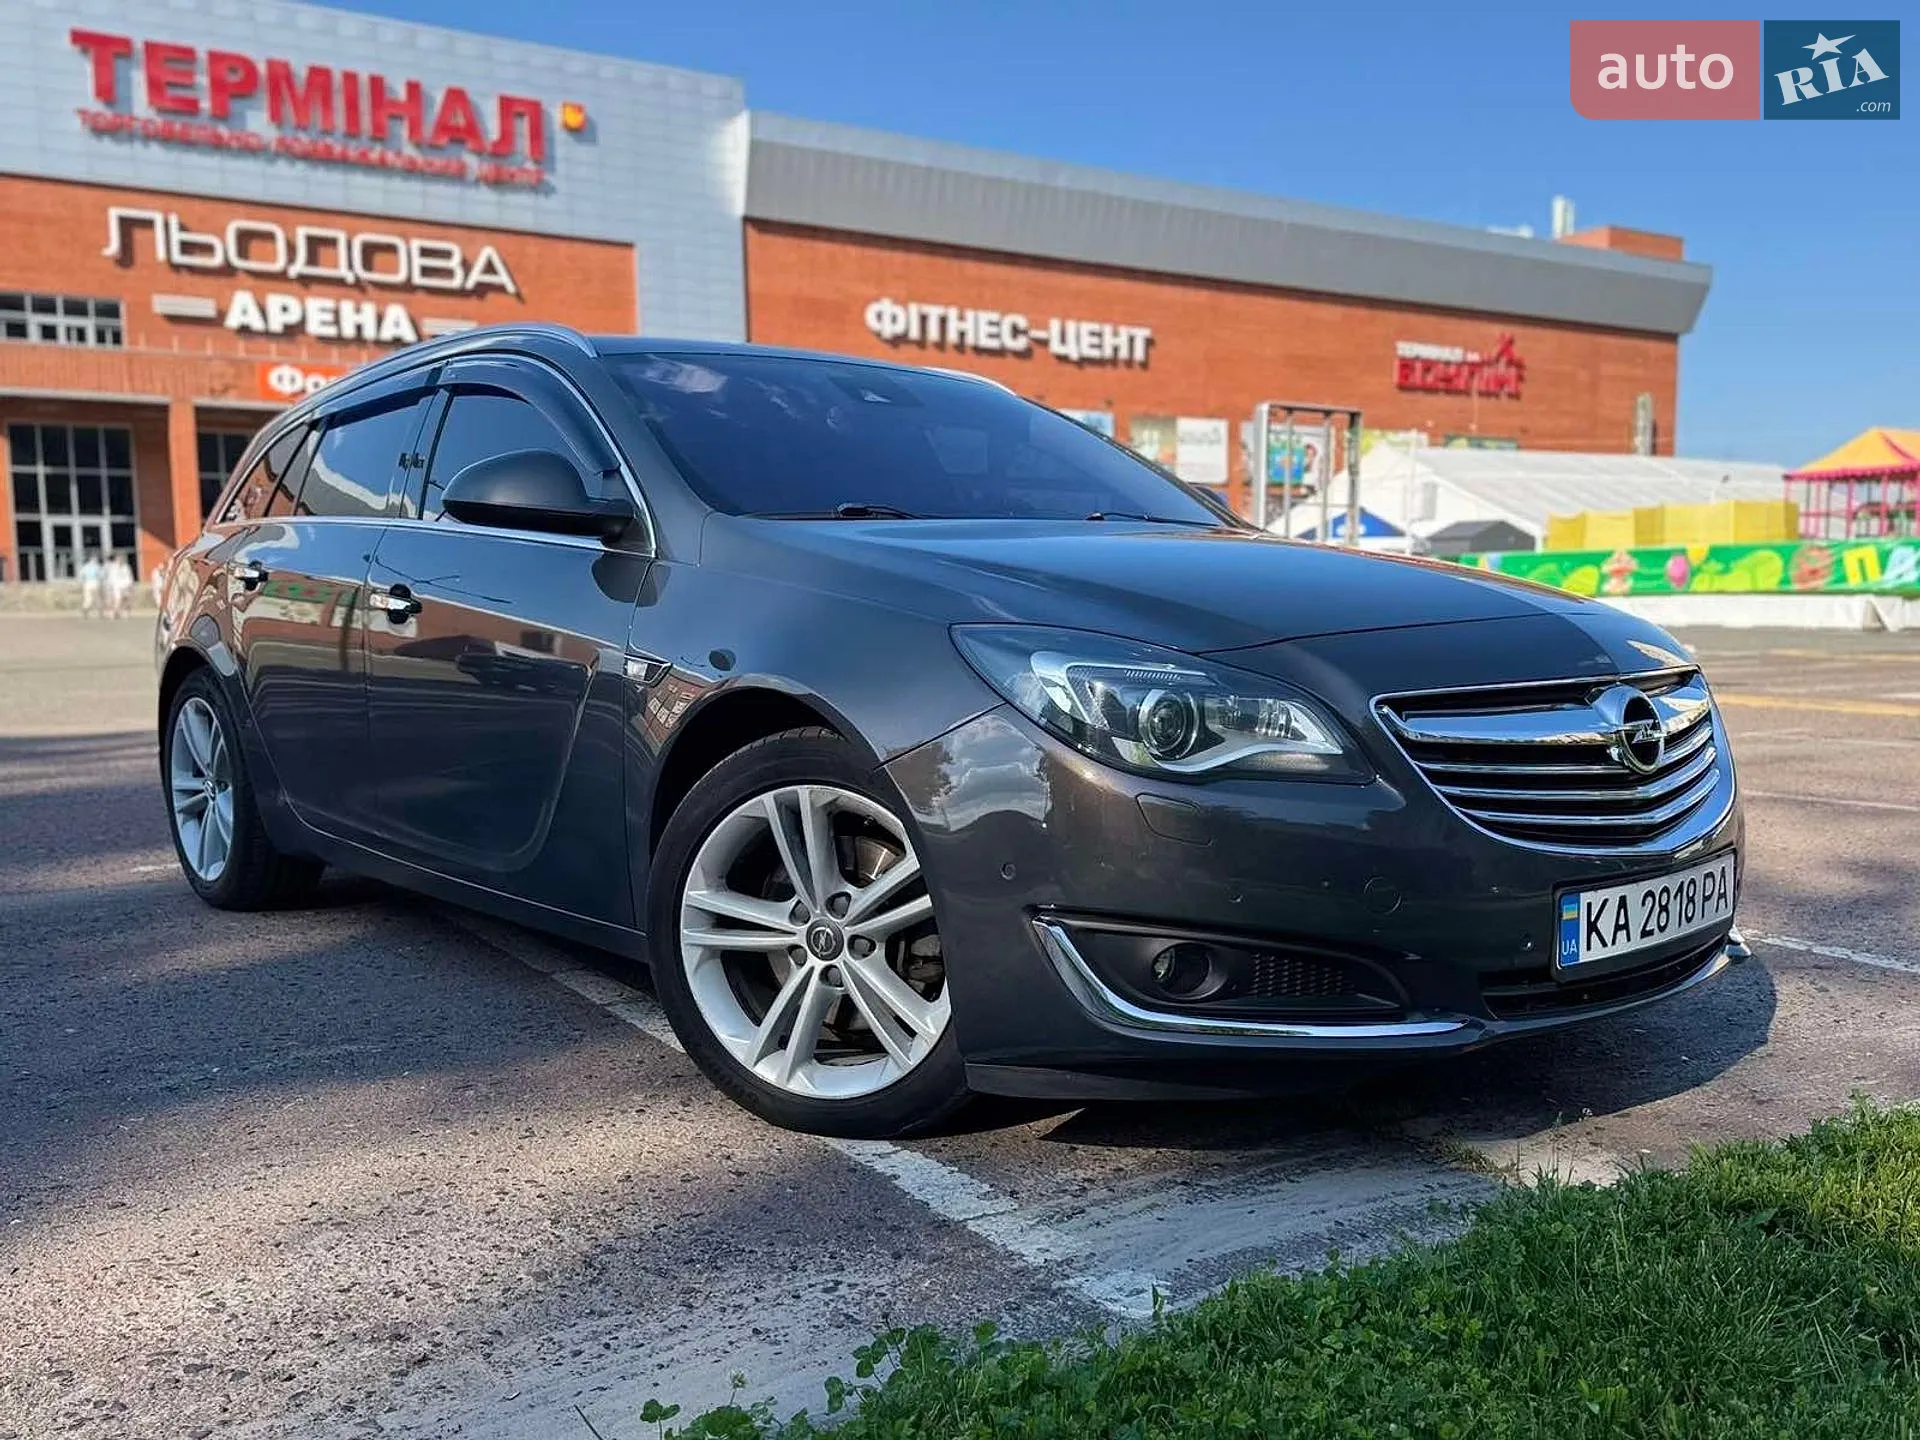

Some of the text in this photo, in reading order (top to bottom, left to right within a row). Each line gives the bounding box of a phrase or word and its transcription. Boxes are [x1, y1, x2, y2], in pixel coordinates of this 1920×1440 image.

[70, 28, 545, 160] ТЕРМІНАЛ
[103, 207, 517, 294] ЛЬОДОВА
[224, 290, 418, 343] АРЕНА
[1561, 940, 1577, 955] UA
[1586, 866, 1728, 951] KA 2818 PA
